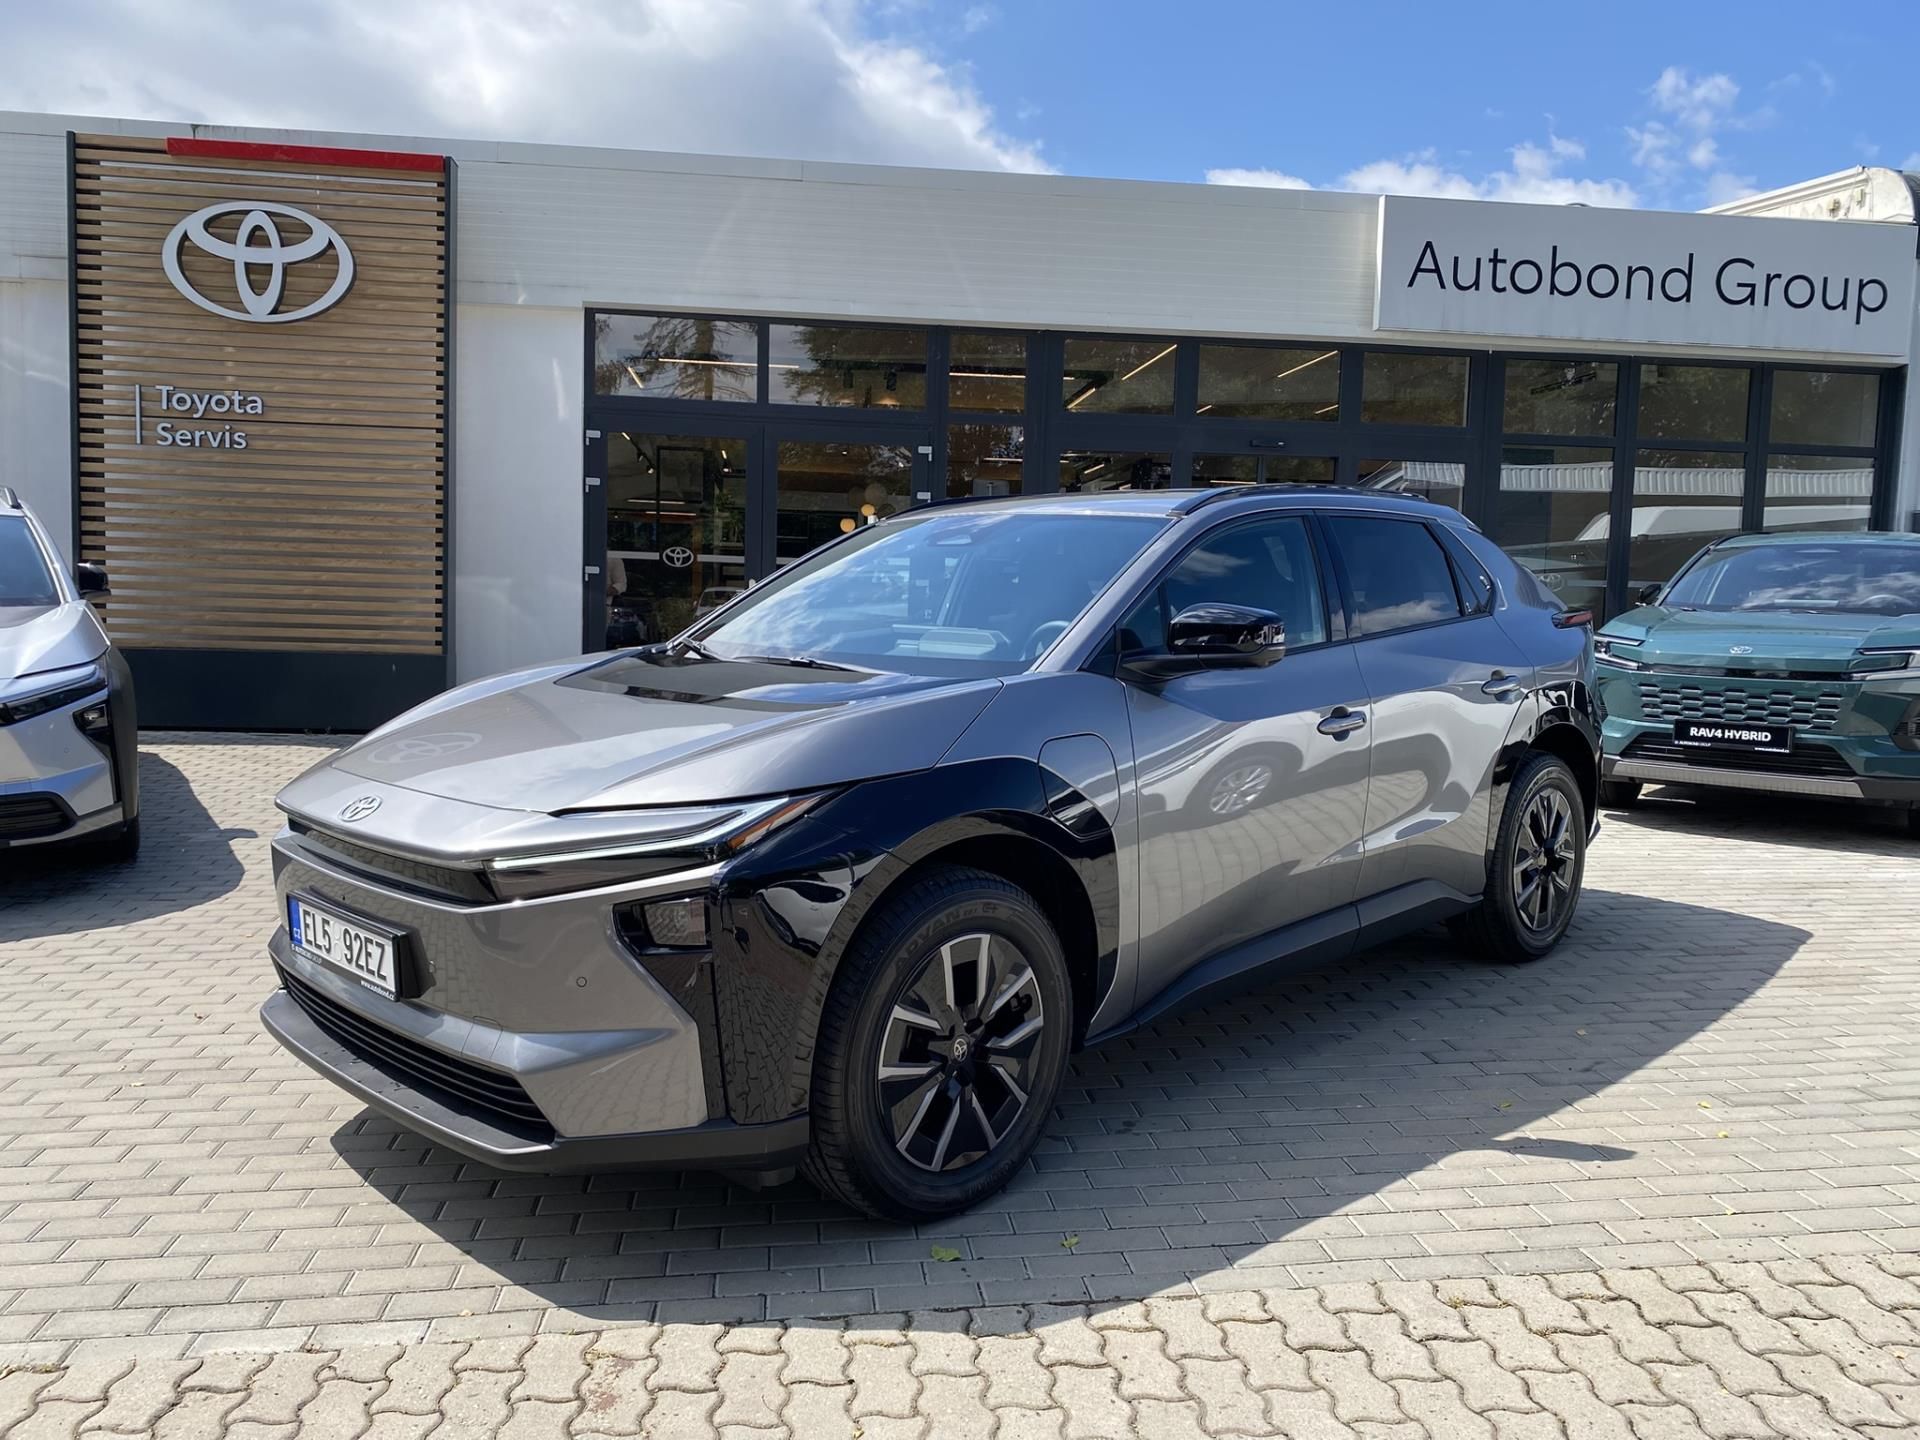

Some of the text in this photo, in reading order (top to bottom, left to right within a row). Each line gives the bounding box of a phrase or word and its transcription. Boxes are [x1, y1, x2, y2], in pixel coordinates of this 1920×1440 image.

[1407, 240, 1889, 325] Autobond Group
[155, 385, 264, 418] Toyota
[156, 422, 248, 449] Servis
[1689, 726, 1772, 742] RAV4 HYBRID
[302, 908, 332, 954] EL5
[343, 927, 387, 982] 92EZ
